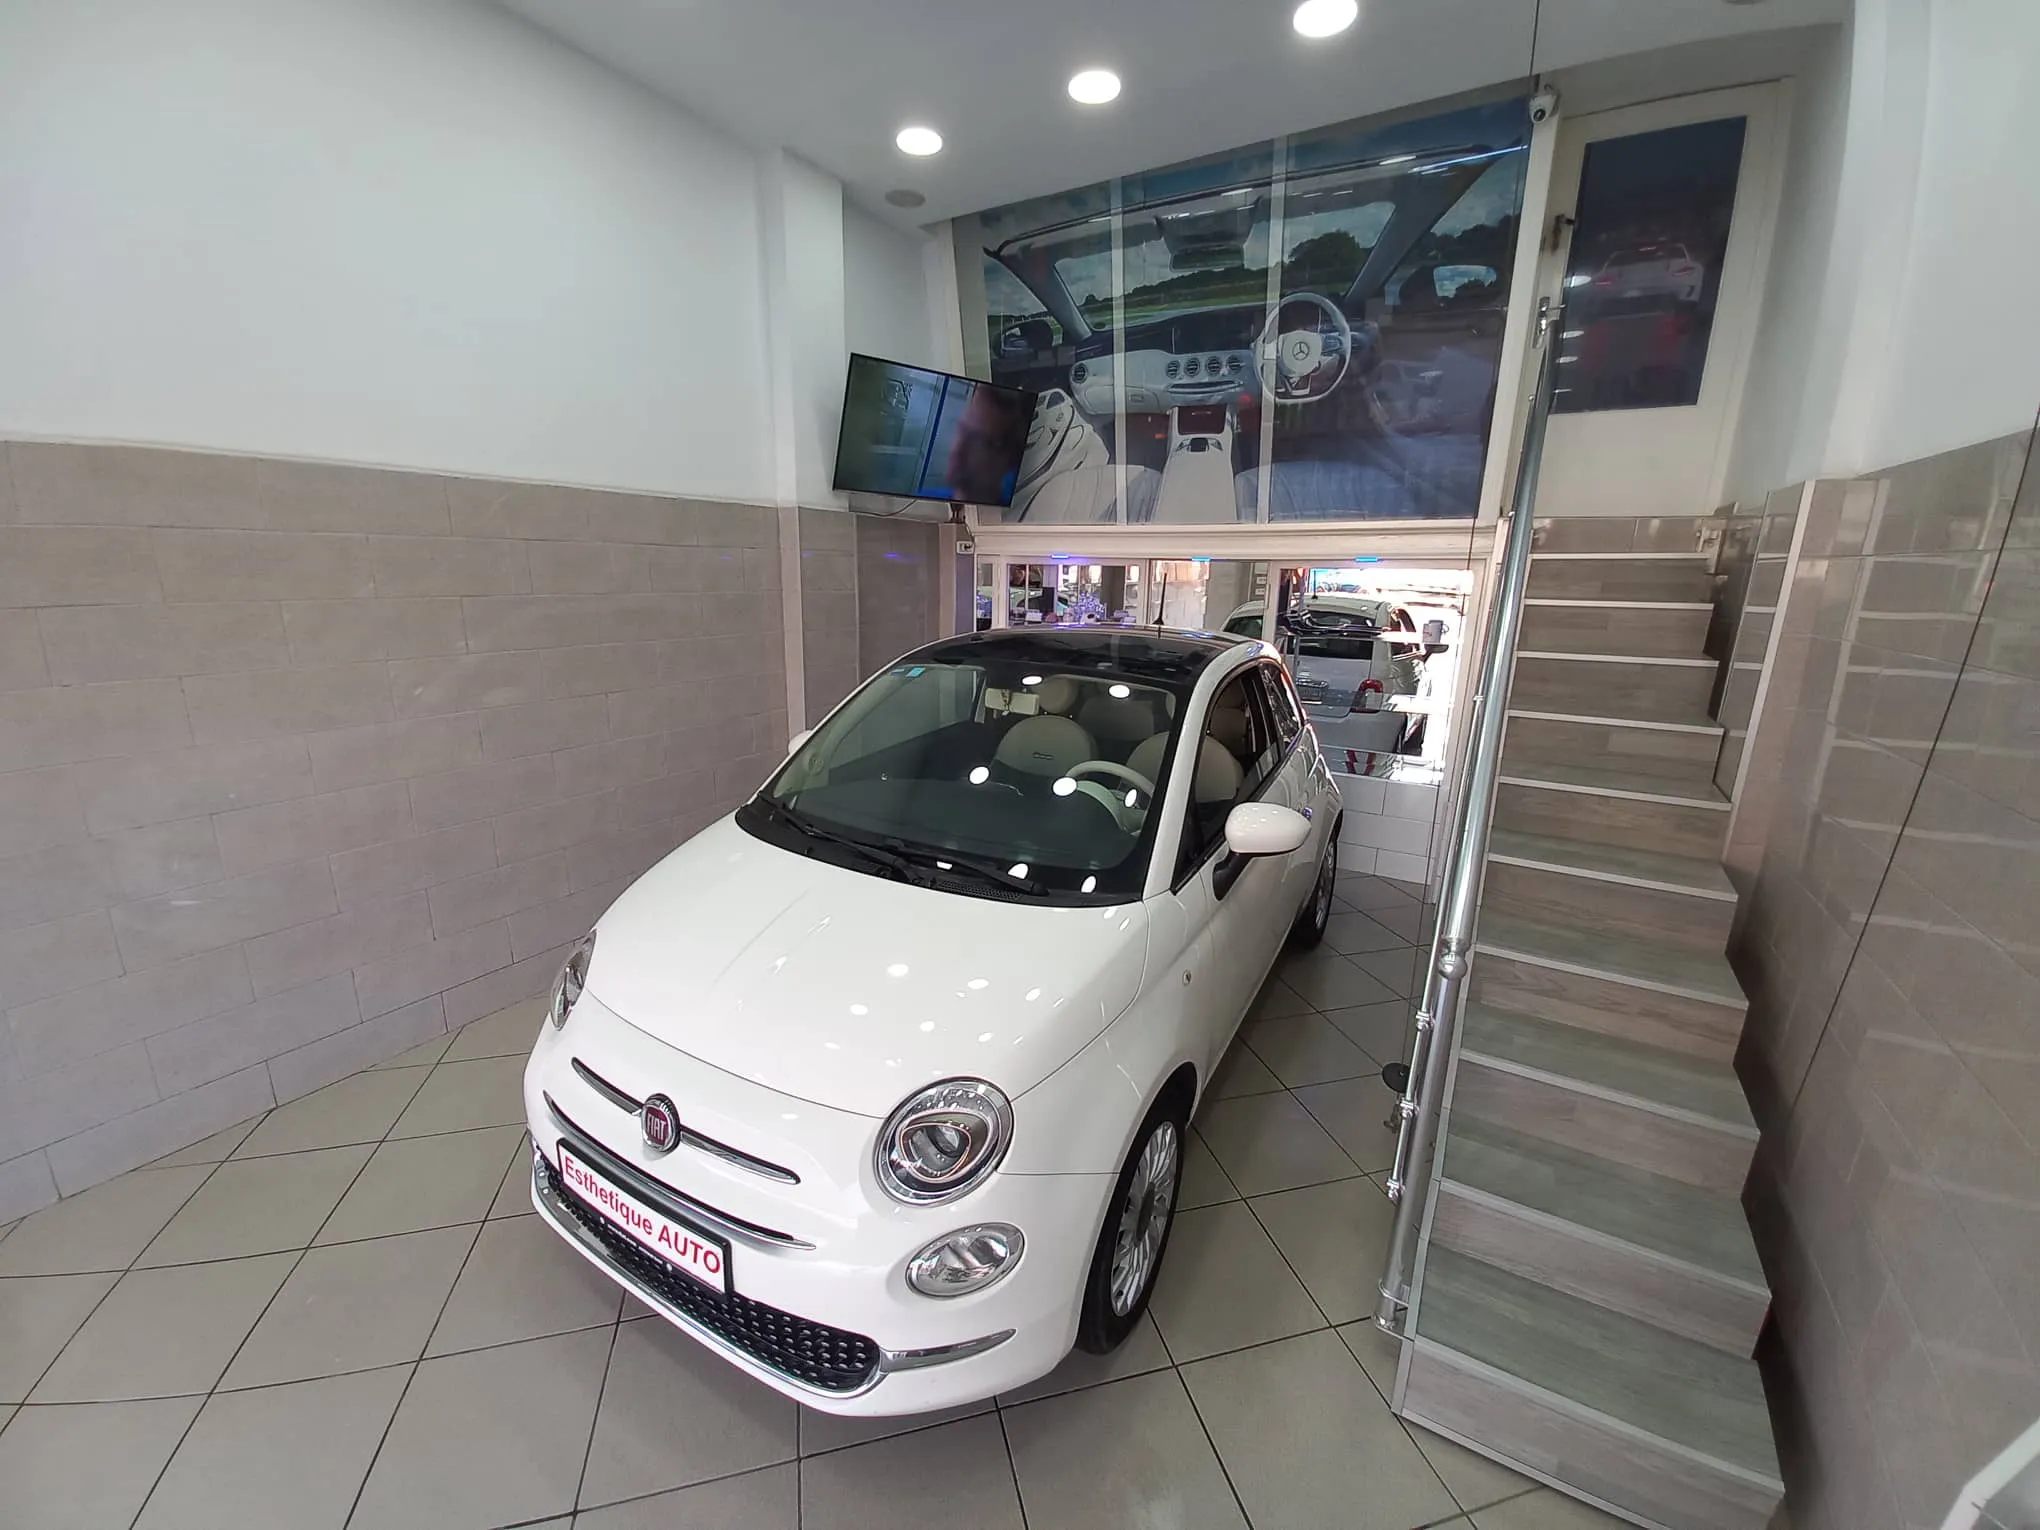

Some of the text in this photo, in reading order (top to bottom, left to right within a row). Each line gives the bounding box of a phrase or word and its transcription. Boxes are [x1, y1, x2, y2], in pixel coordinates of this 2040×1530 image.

[647, 1112, 666, 1140] FIAT
[565, 1156, 720, 1274] Esthetique AUTO
